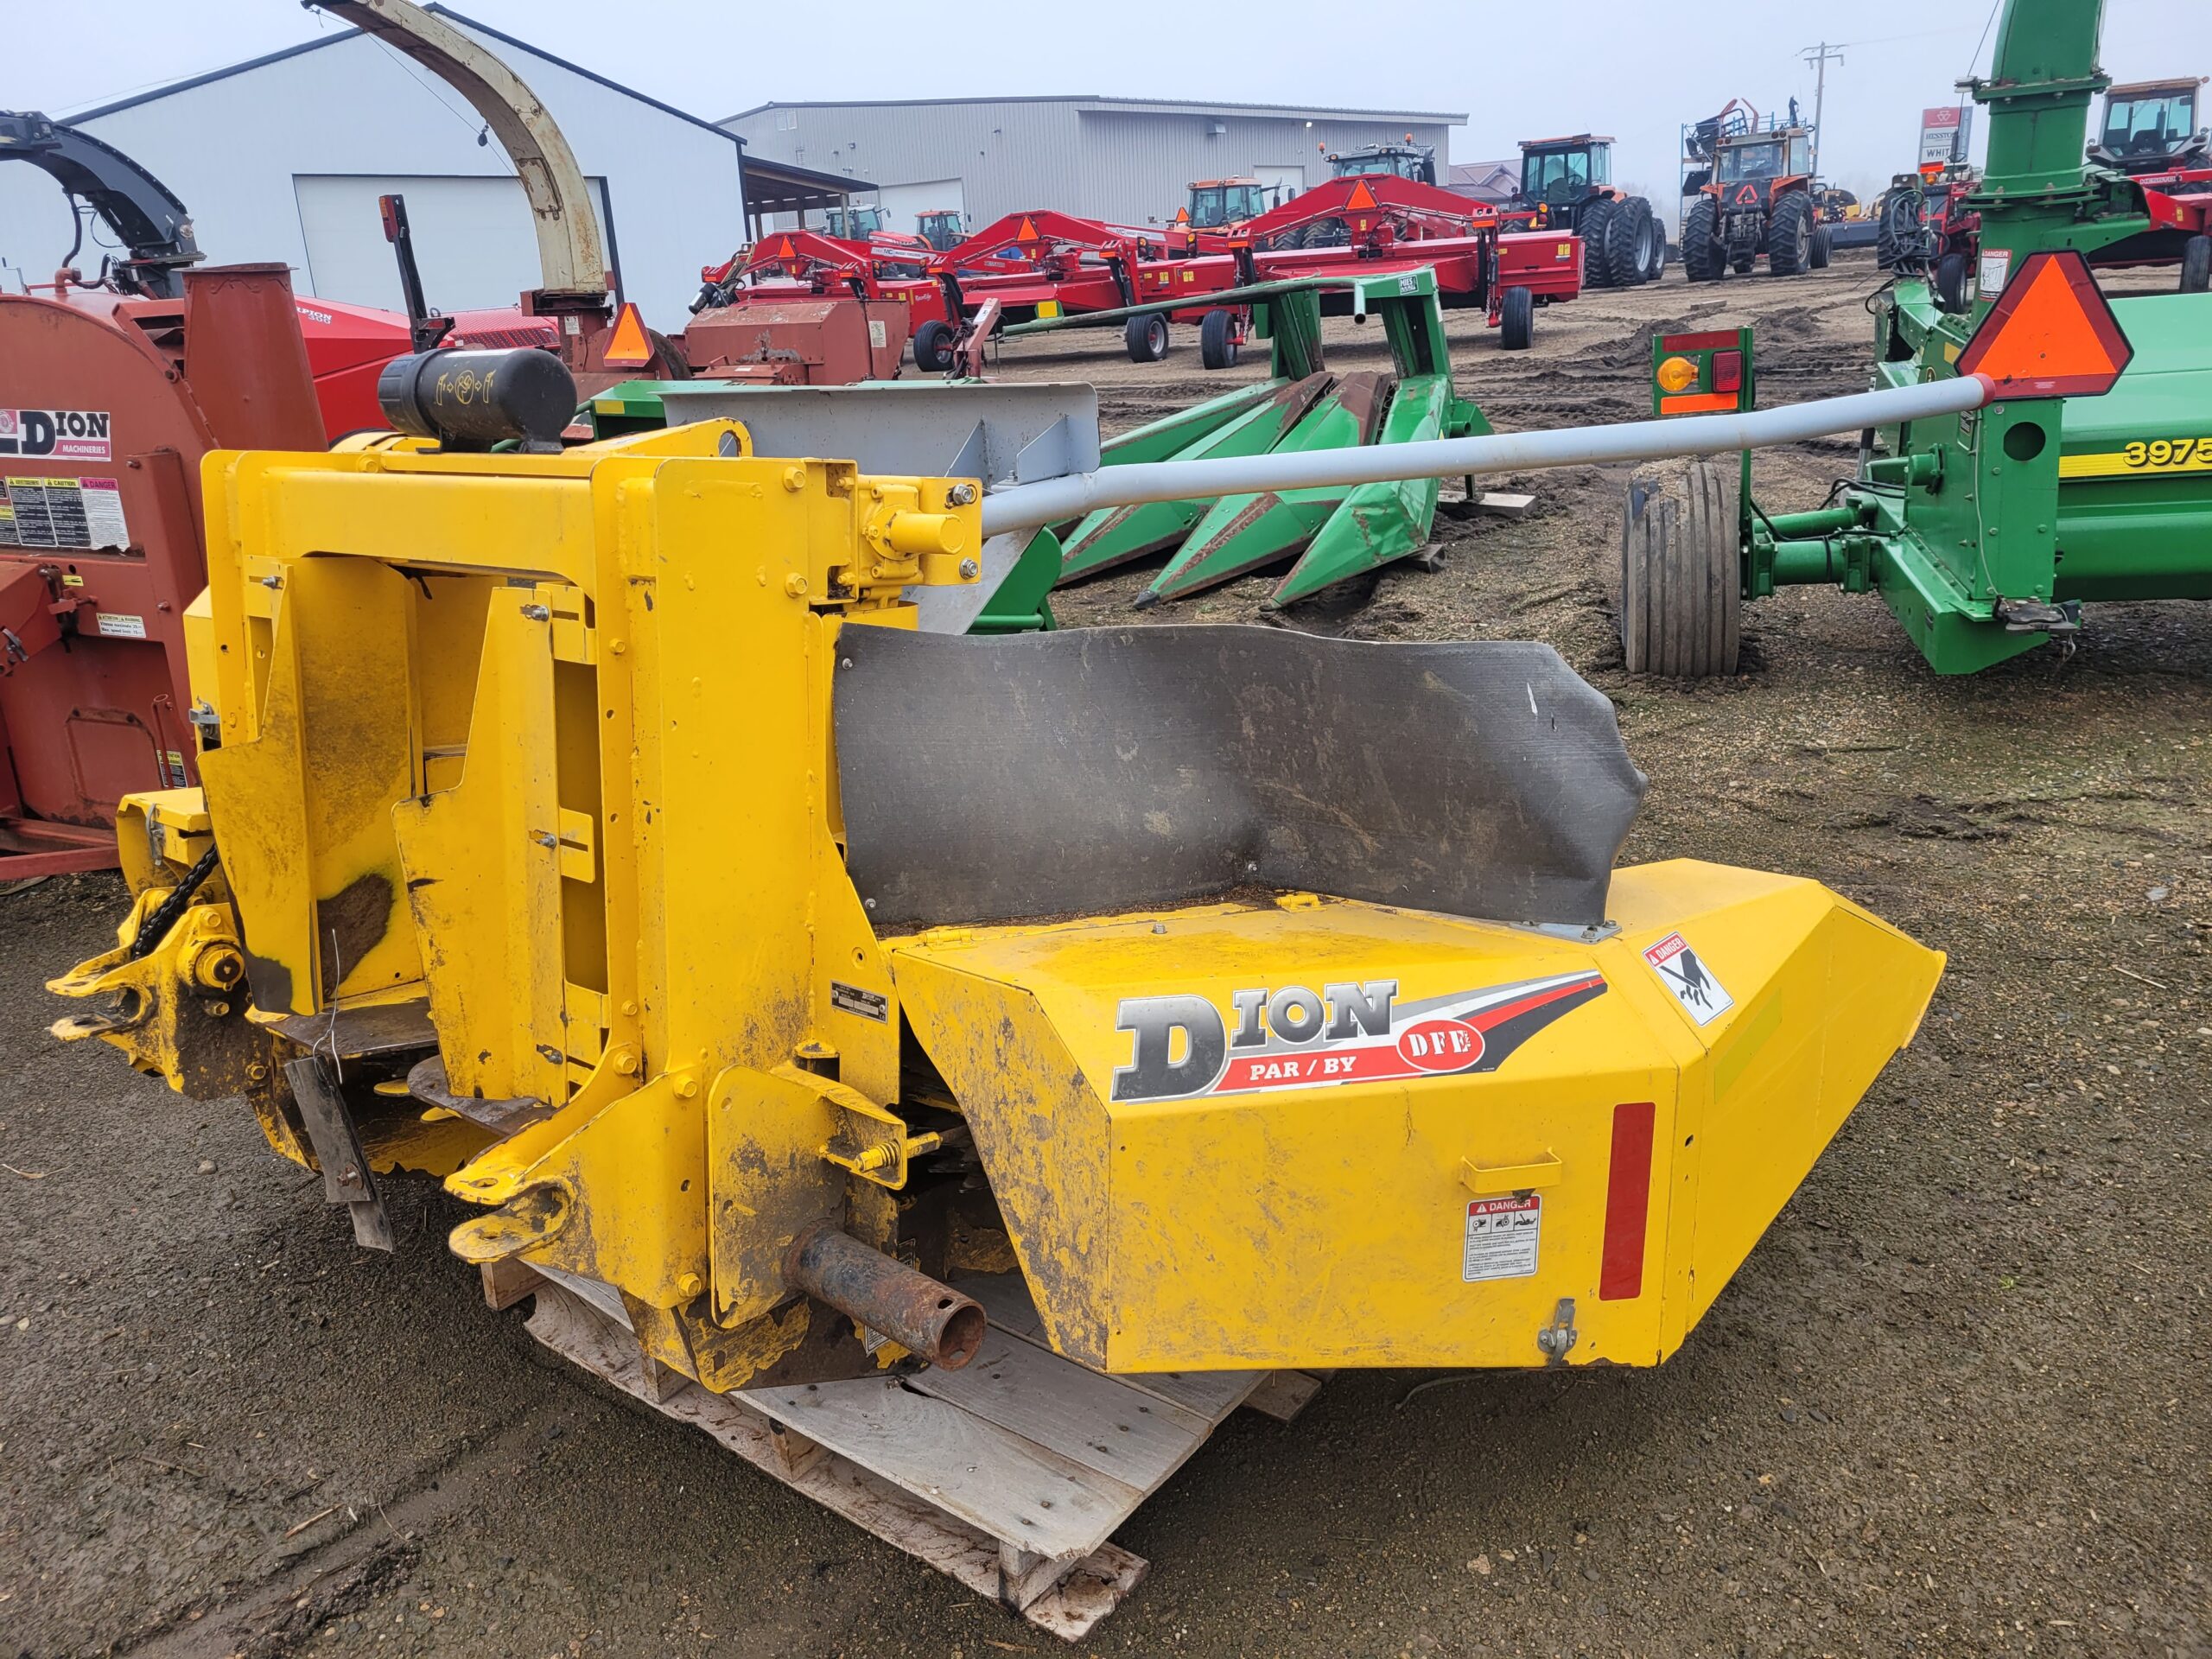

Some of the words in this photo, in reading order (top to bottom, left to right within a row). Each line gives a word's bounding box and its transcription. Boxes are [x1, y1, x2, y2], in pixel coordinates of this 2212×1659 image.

[1926, 148, 1950, 157] WHIT
[296, 306, 332, 321] RPION
[19, 410, 109, 455] DION
[62, 444, 105, 454] MACHINERIES
[2122, 438, 2212, 467] 3975
[89, 480, 117, 489] DANGER
[1655, 938, 1685, 960] DANGER
[1110, 980, 1397, 1102] DION
[1249, 1060, 1300, 1081] PAR
[1323, 1056, 1357, 1075] BY
